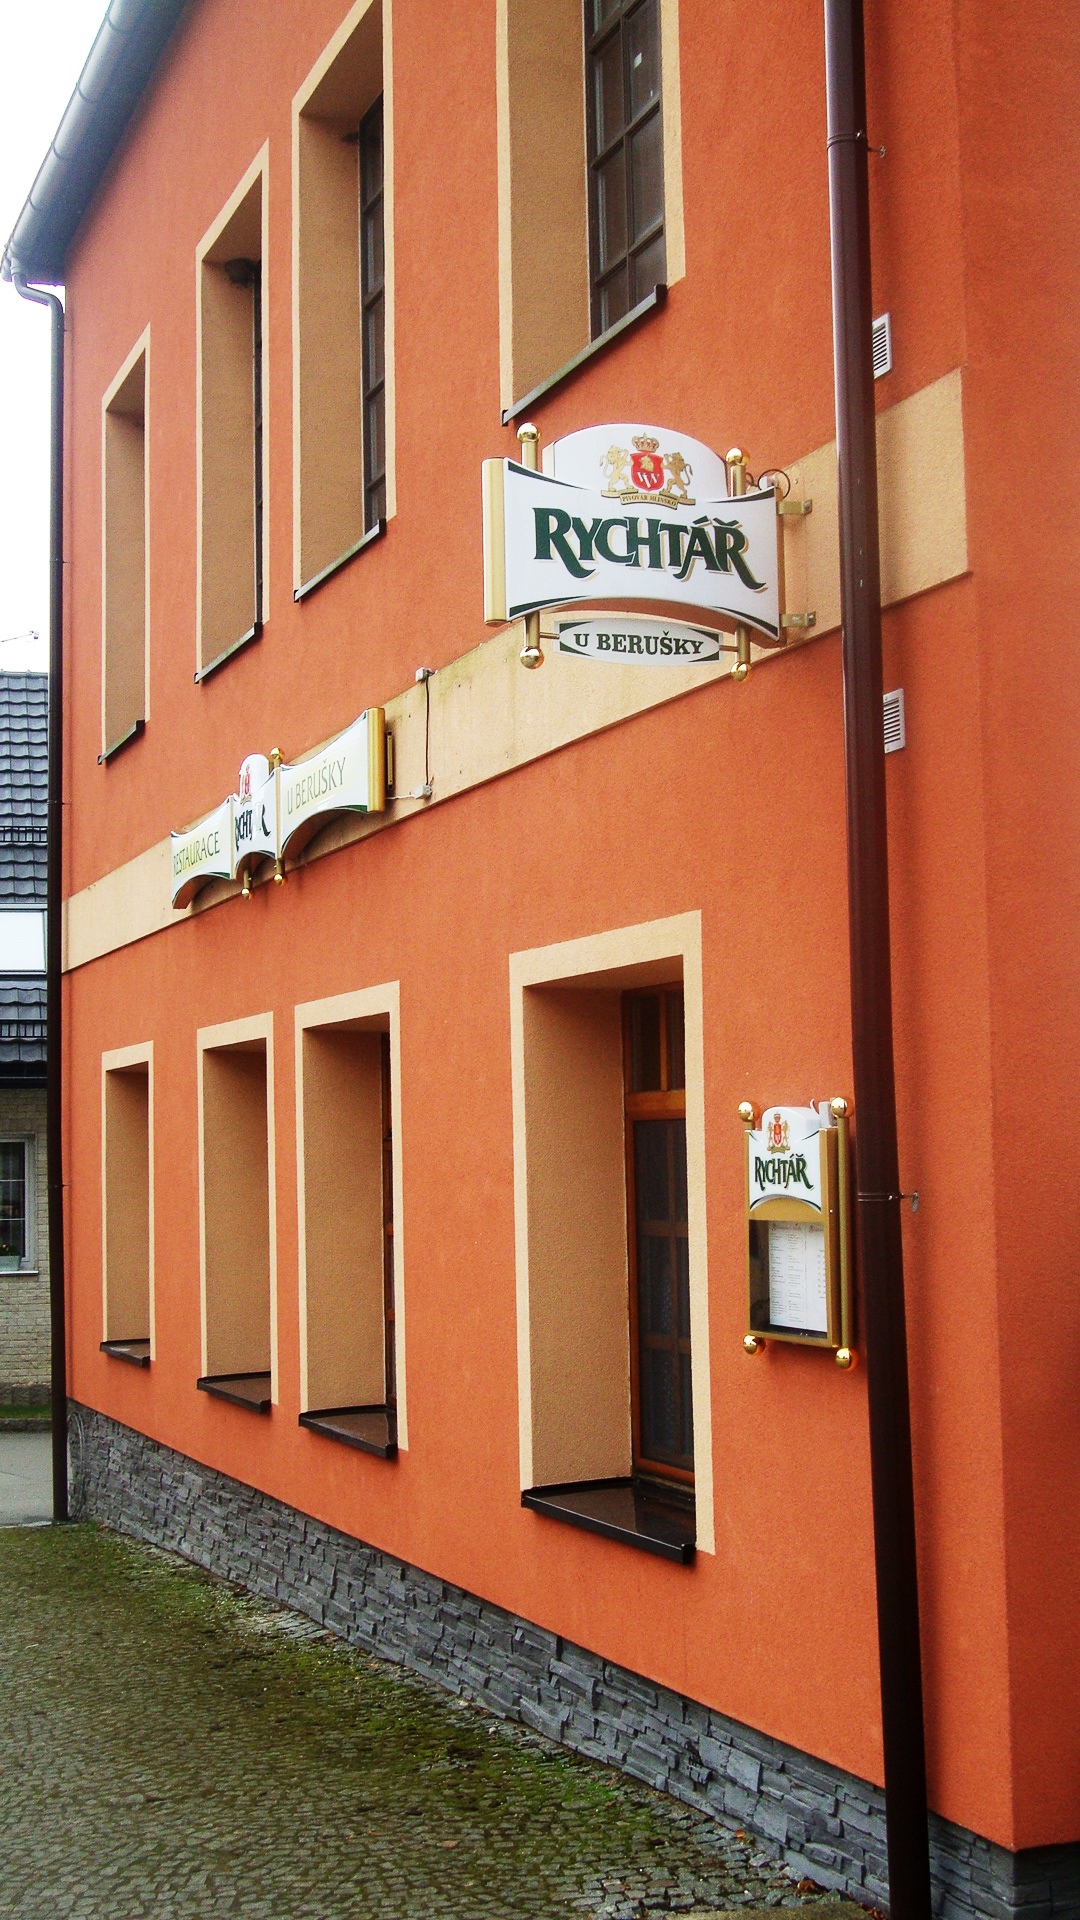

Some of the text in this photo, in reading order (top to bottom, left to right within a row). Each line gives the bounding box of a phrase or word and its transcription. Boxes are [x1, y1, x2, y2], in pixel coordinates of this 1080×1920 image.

[532, 507, 767, 591] RYCHTÁŘ
[573, 631, 704, 655] U BERUŠKY
[287, 757, 346, 815] U BERUŠKY
[755, 1153, 814, 1191] RYCHTÁŘ
